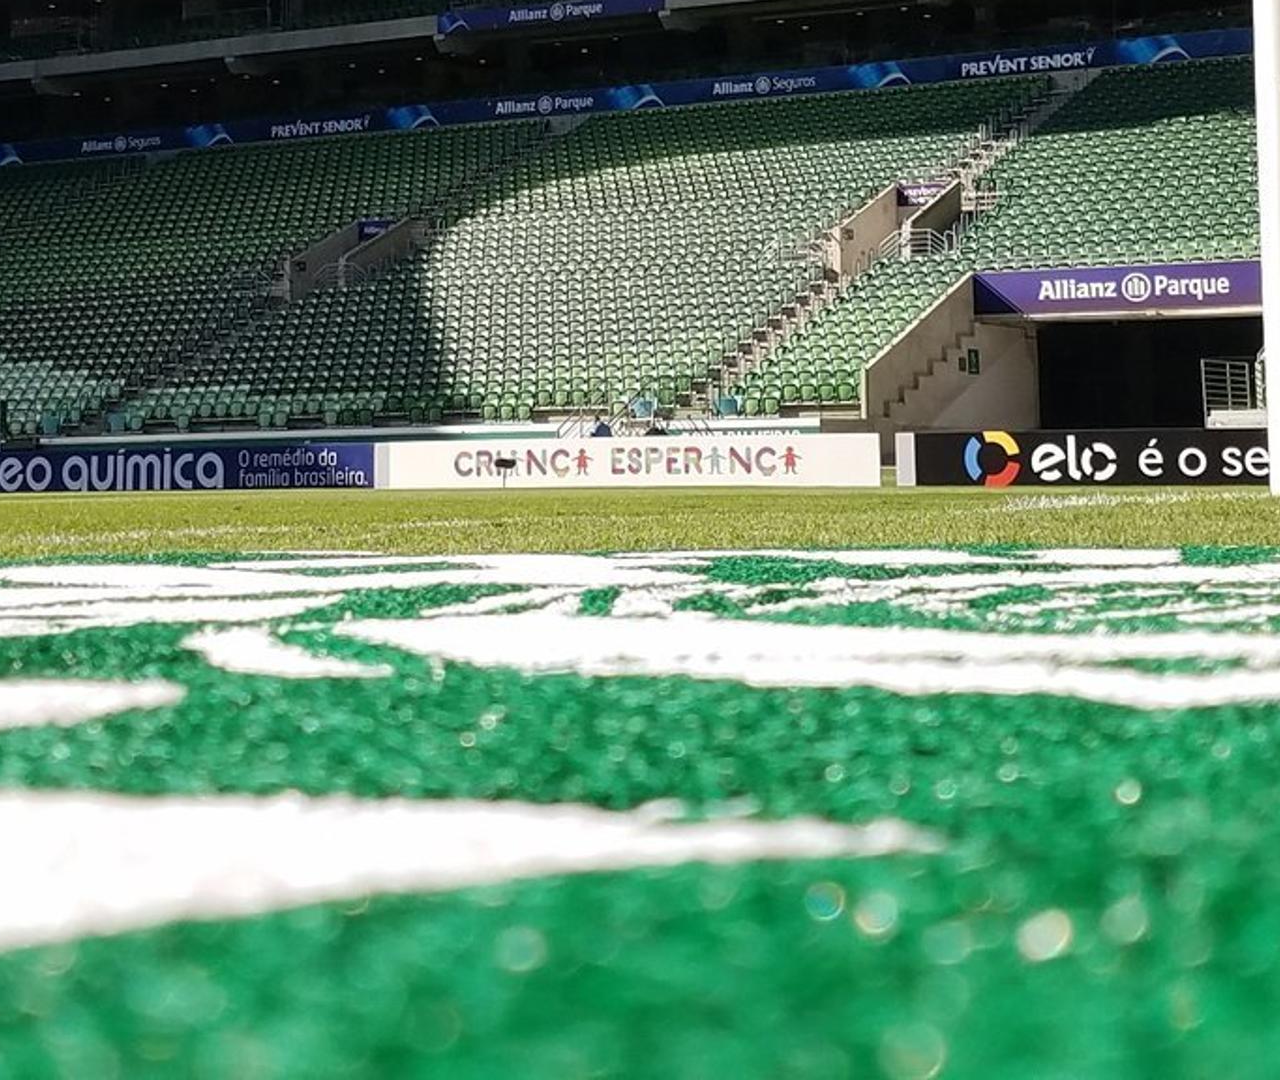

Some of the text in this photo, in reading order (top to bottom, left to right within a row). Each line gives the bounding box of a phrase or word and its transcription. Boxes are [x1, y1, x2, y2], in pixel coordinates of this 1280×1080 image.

[508, 3, 603, 22] Allianz Parque
[961, 52, 1087, 77] PREVENT SENIOR
[713, 77, 816, 95] Allianz Seguros
[495, 97, 595, 115] Allianz Parque
[271, 117, 364, 138] PREVENT SENIOR
[81, 136, 161, 154] Allianz Seguros
[1038, 275, 1231, 301] Allianz Parque
[238, 448, 338, 467] O remédio da
[1031, 435, 1117, 481] elo
[1138, 438, 1164, 477] é
[1177, 448, 1207, 477] o
[1221, 448, 1270, 477] se
[62, 447, 225, 492] química
[239, 464, 369, 488] família brasileira.
